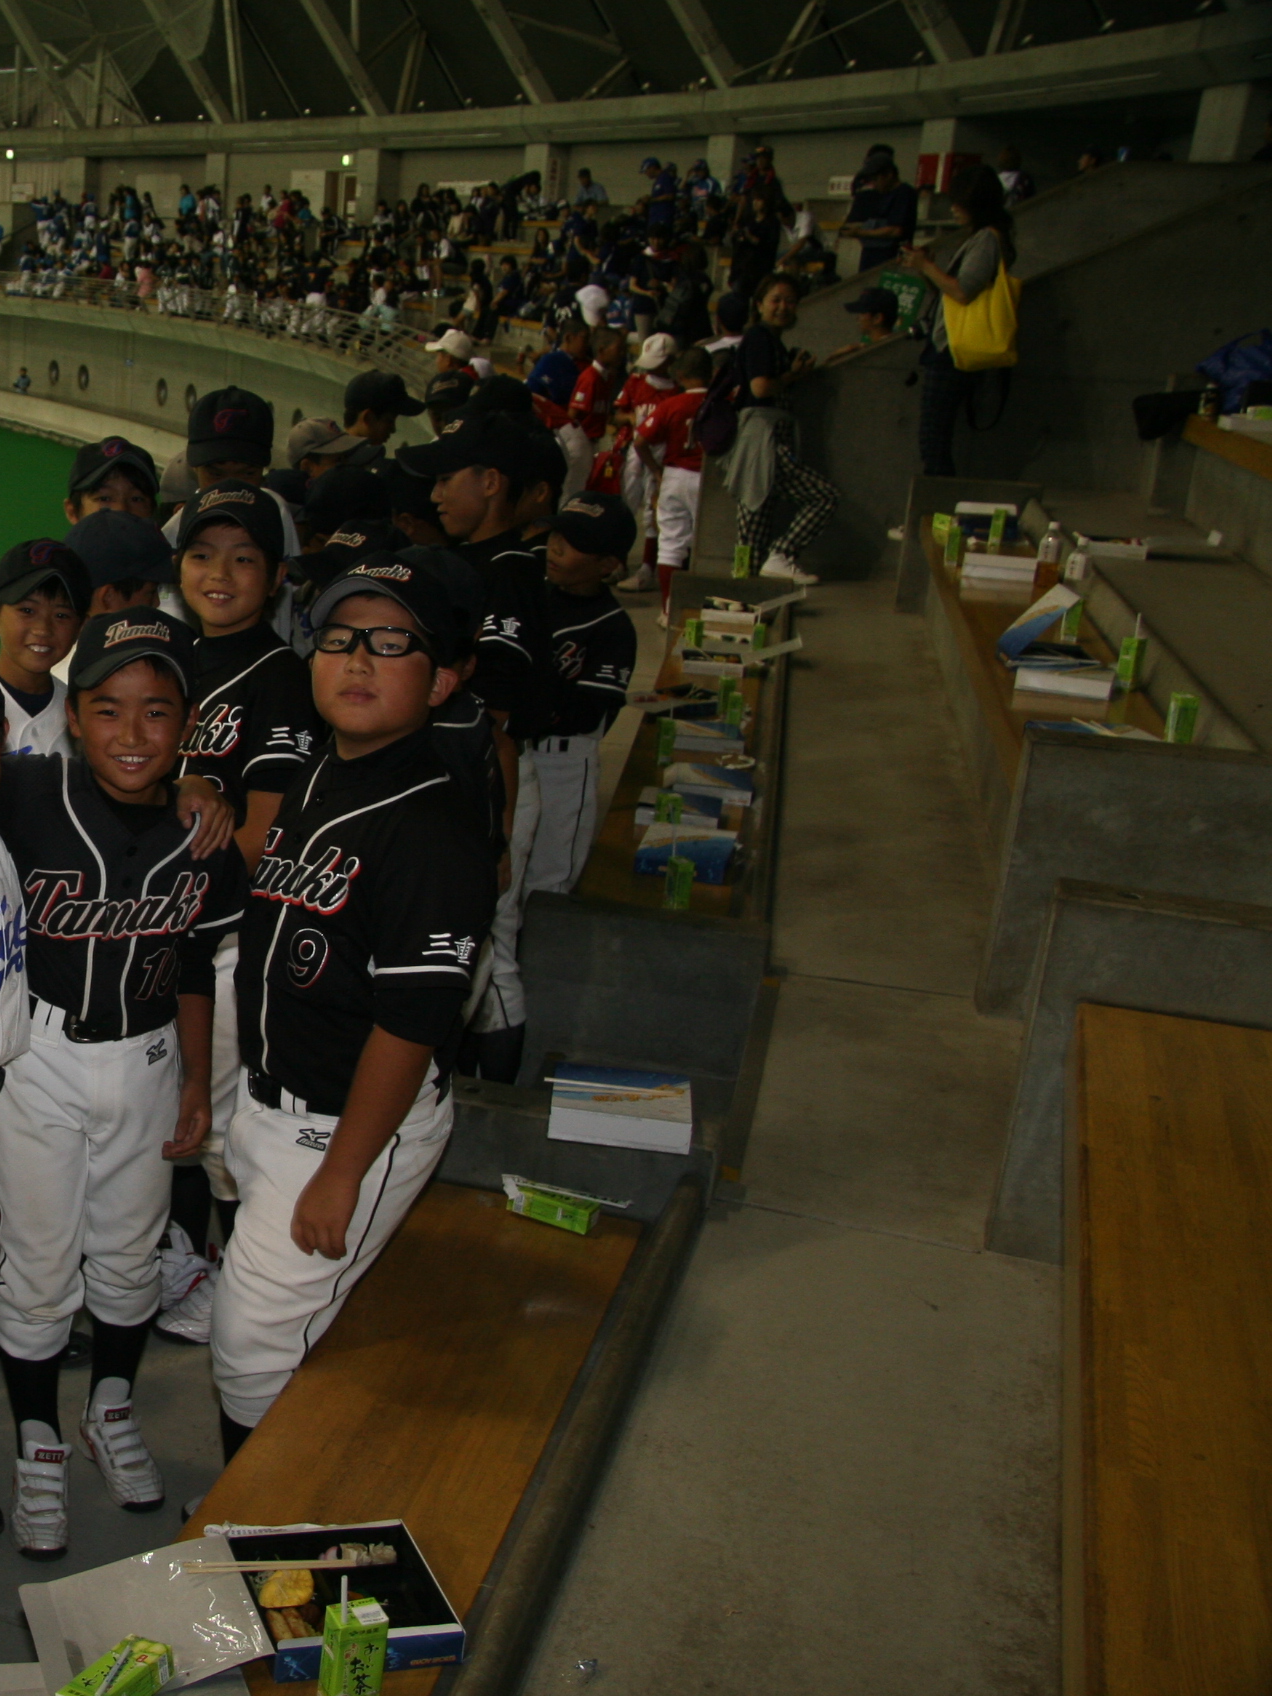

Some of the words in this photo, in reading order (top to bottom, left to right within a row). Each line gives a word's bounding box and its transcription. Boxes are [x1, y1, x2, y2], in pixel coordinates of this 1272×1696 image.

[197, 488, 255, 513] Tamaki
[103, 620, 171, 648] Tamaki
[482, 614, 521, 638] 三重
[266, 726, 314, 756] 三重
[24, 868, 214, 942] Tamaki
[287, 928, 332, 989] 9
[421, 932, 476, 966] 三重
[36, 1451, 65, 1461] ZETT
